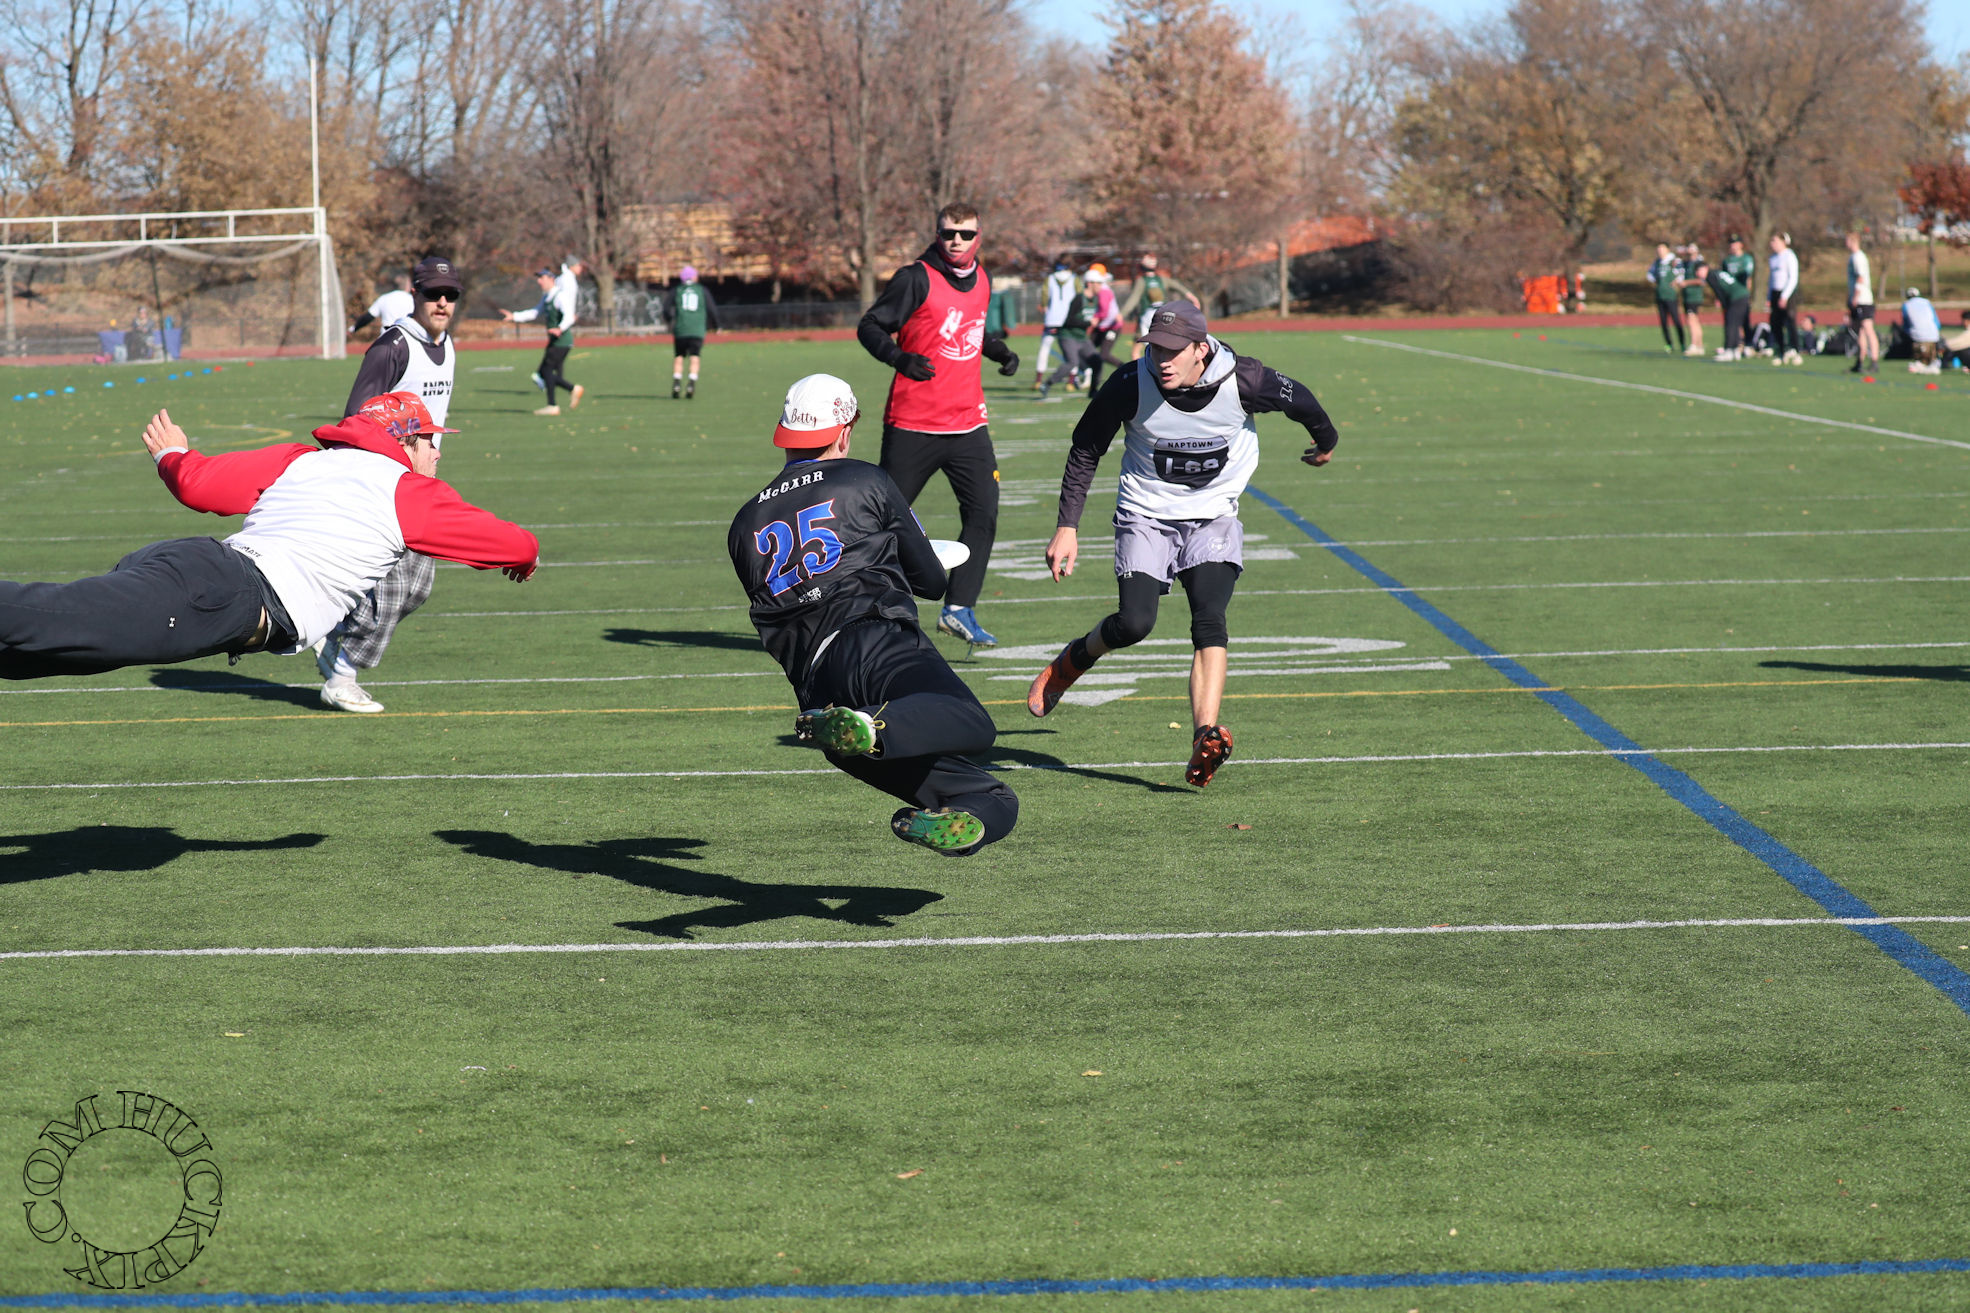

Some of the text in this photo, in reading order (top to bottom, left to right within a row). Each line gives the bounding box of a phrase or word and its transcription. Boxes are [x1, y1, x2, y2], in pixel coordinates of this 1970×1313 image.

[681, 293, 700, 312] 10
[791, 408, 817, 428] Betty
[1168, 441, 1213, 449] NAPTOWN
[1165, 457, 1220, 475] I-69
[753, 498, 845, 597] 25
